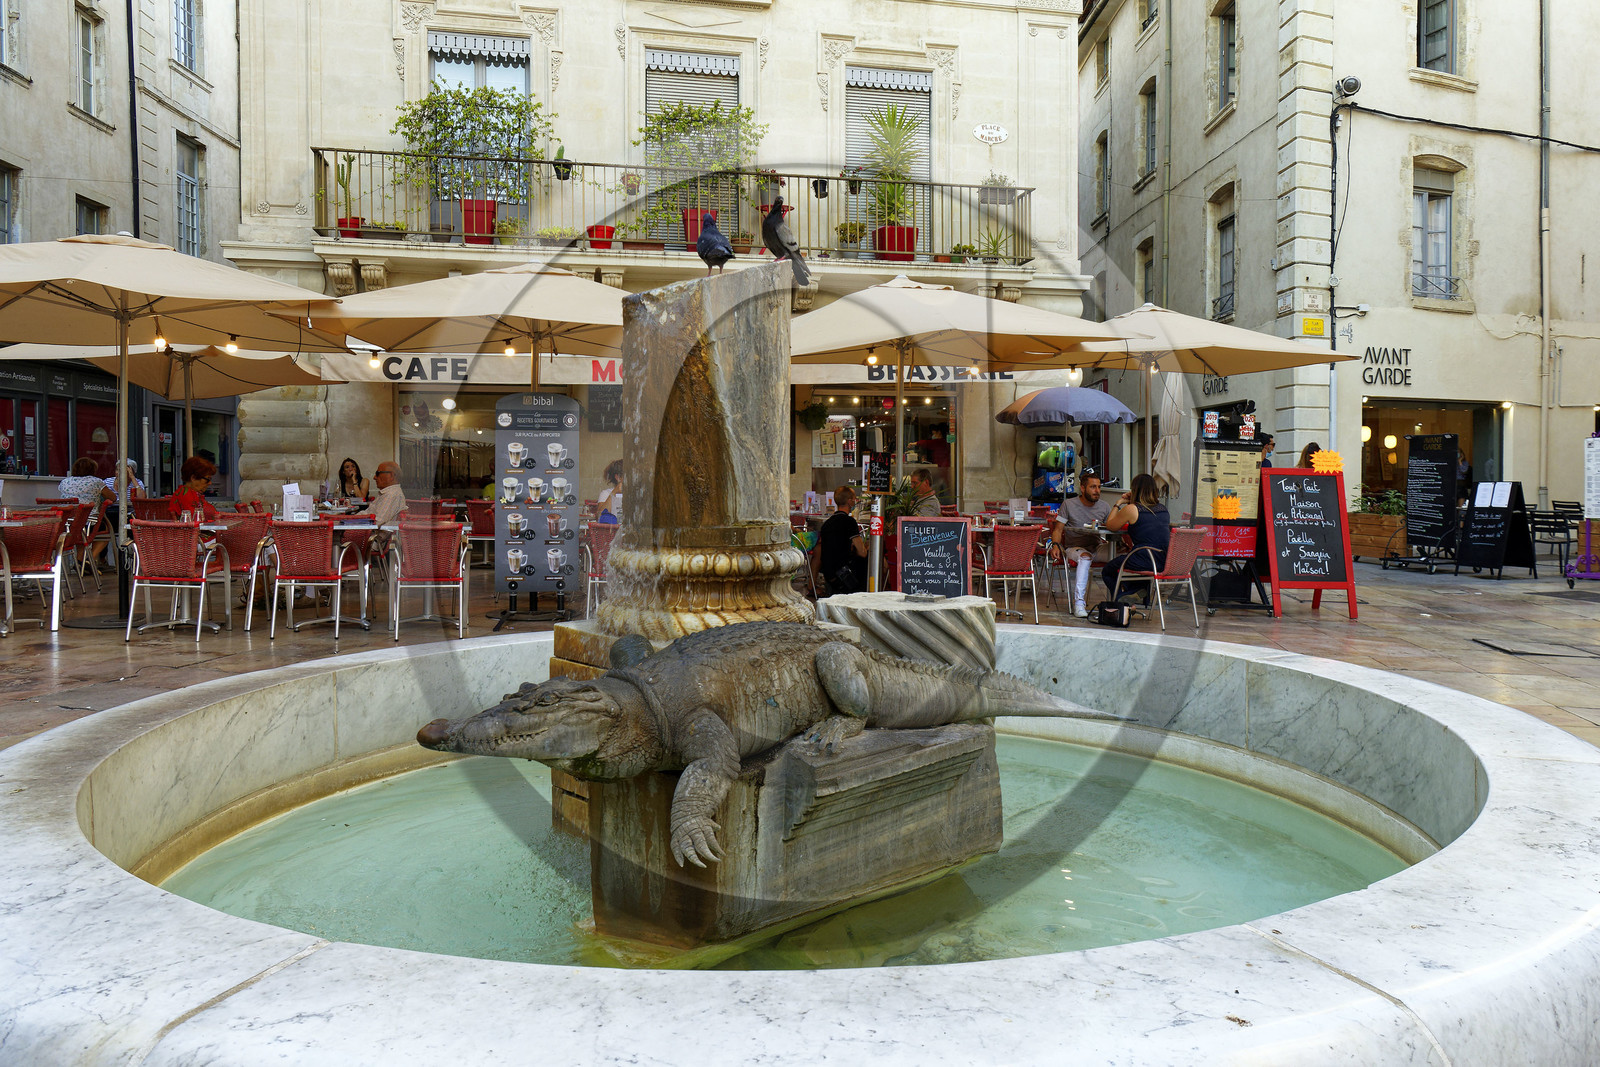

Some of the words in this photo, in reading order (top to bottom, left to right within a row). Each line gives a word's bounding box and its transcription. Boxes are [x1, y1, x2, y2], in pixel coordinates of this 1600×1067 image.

[1363, 346, 1412, 366] AVANT
[382, 356, 468, 381] CAFE
[12, 372, 36, 382] Artisanale
[1362, 367, 1412, 386] GARDE
[1204, 376, 1229, 396] GARDE
[533, 395, 554, 406] bibal
[1205, 413, 1218, 421] 2019
[1423, 443, 1443, 451] GARDE
[1277, 478, 1297, 492] Tout
[1290, 494, 1322, 509] Maison
[1291, 507, 1325, 520] Artisanal
[909, 530, 956, 546] Bienvenue
[1203, 525, 1230, 538] aella
[923, 545, 955, 563] Veuillez
[1282, 547, 1290, 558] et
[904, 558, 935, 572] patienter
